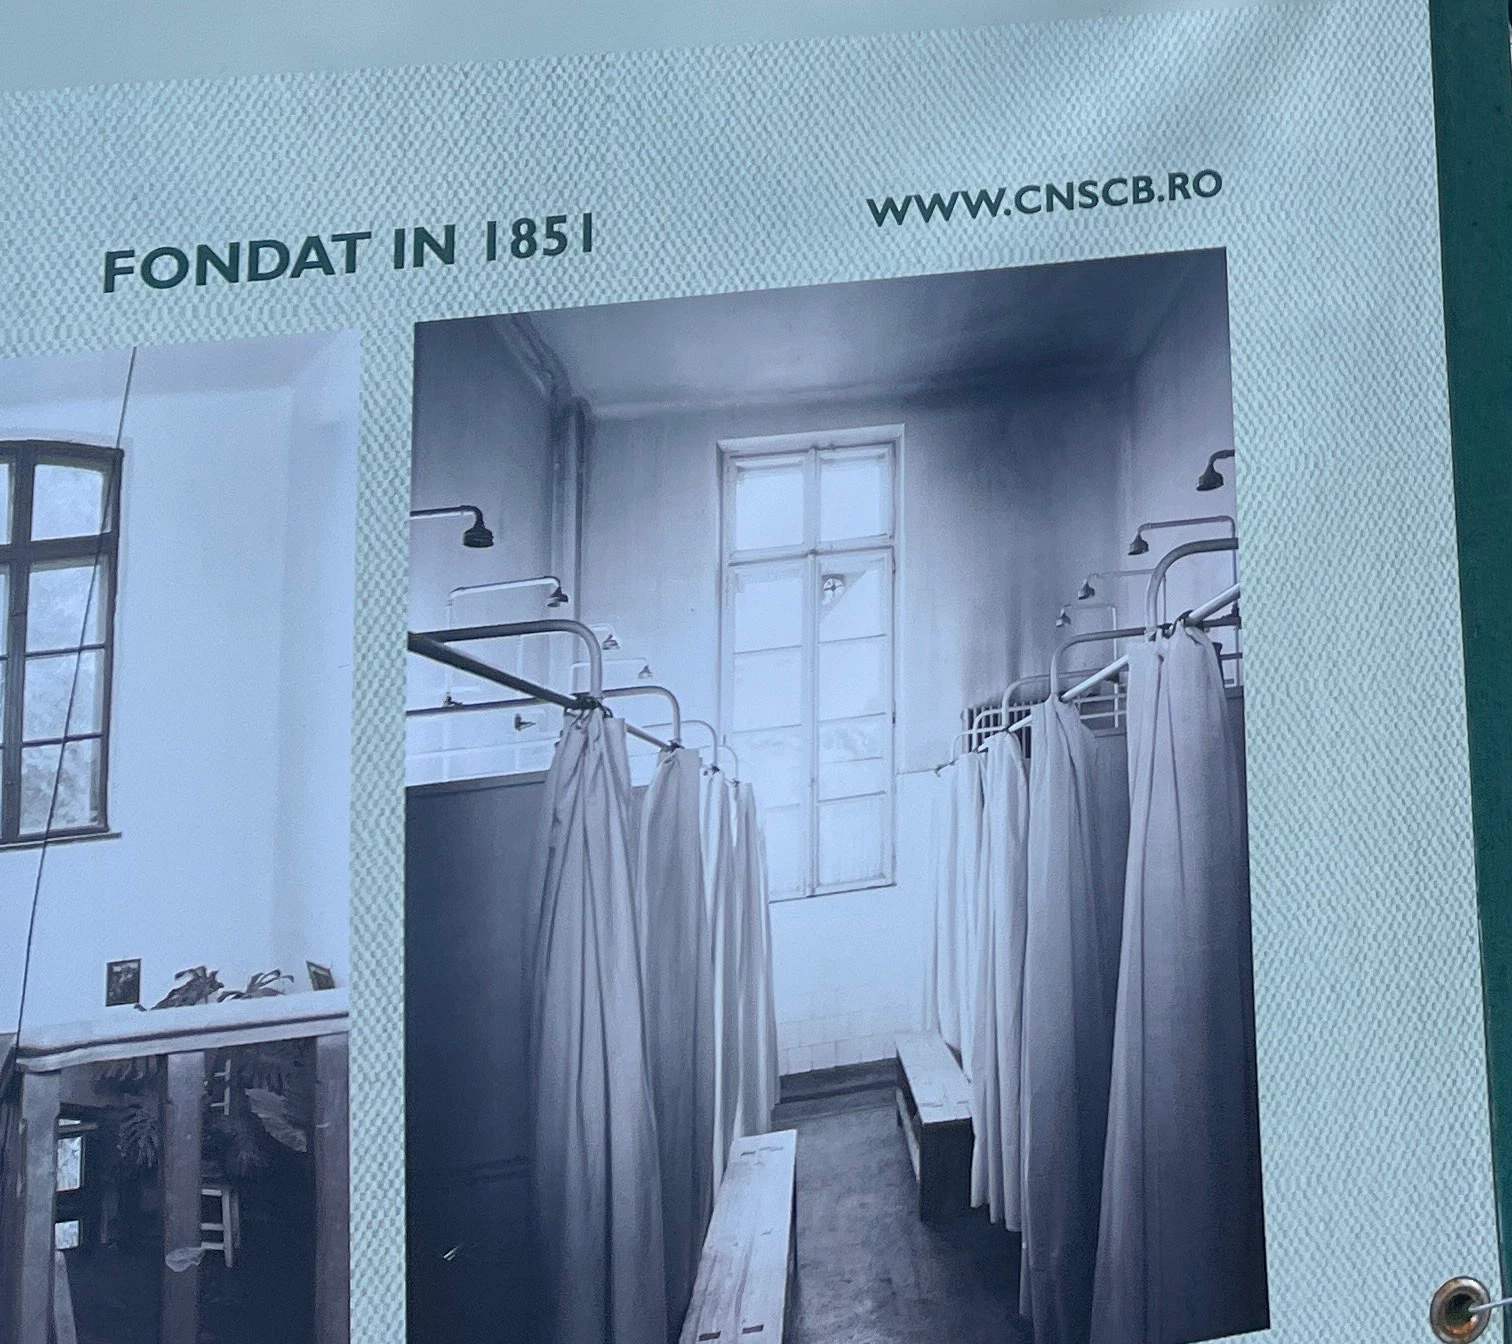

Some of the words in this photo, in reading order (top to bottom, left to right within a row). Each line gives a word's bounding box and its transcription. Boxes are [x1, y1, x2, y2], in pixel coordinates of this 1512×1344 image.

[866, 169, 1223, 228] WWW.CNSCB.RO
[103, 231, 372, 293] FONDAT
[393, 224, 455, 269] IN
[486, 212, 593, 261] 1851
